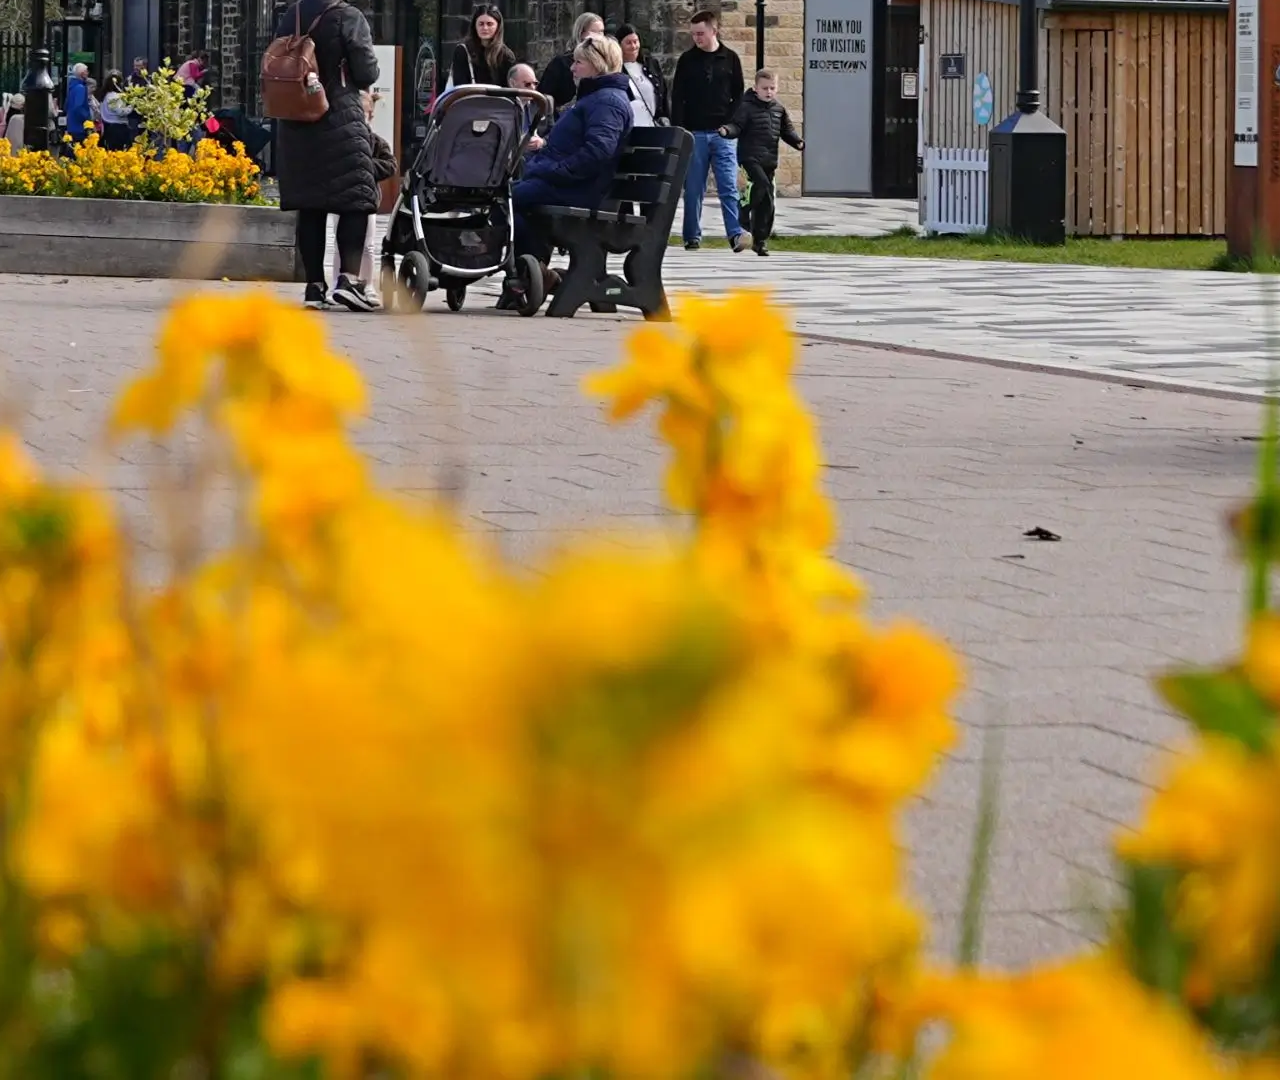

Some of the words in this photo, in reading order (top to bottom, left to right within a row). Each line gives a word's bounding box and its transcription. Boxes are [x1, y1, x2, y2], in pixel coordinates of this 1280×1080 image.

[816, 19, 843, 33] THANK
[846, 20, 862, 34] YOU
[811, 38, 828, 52] FOR
[830, 38, 866, 53] VISITING
[809, 60, 868, 70] HOPETOWN
